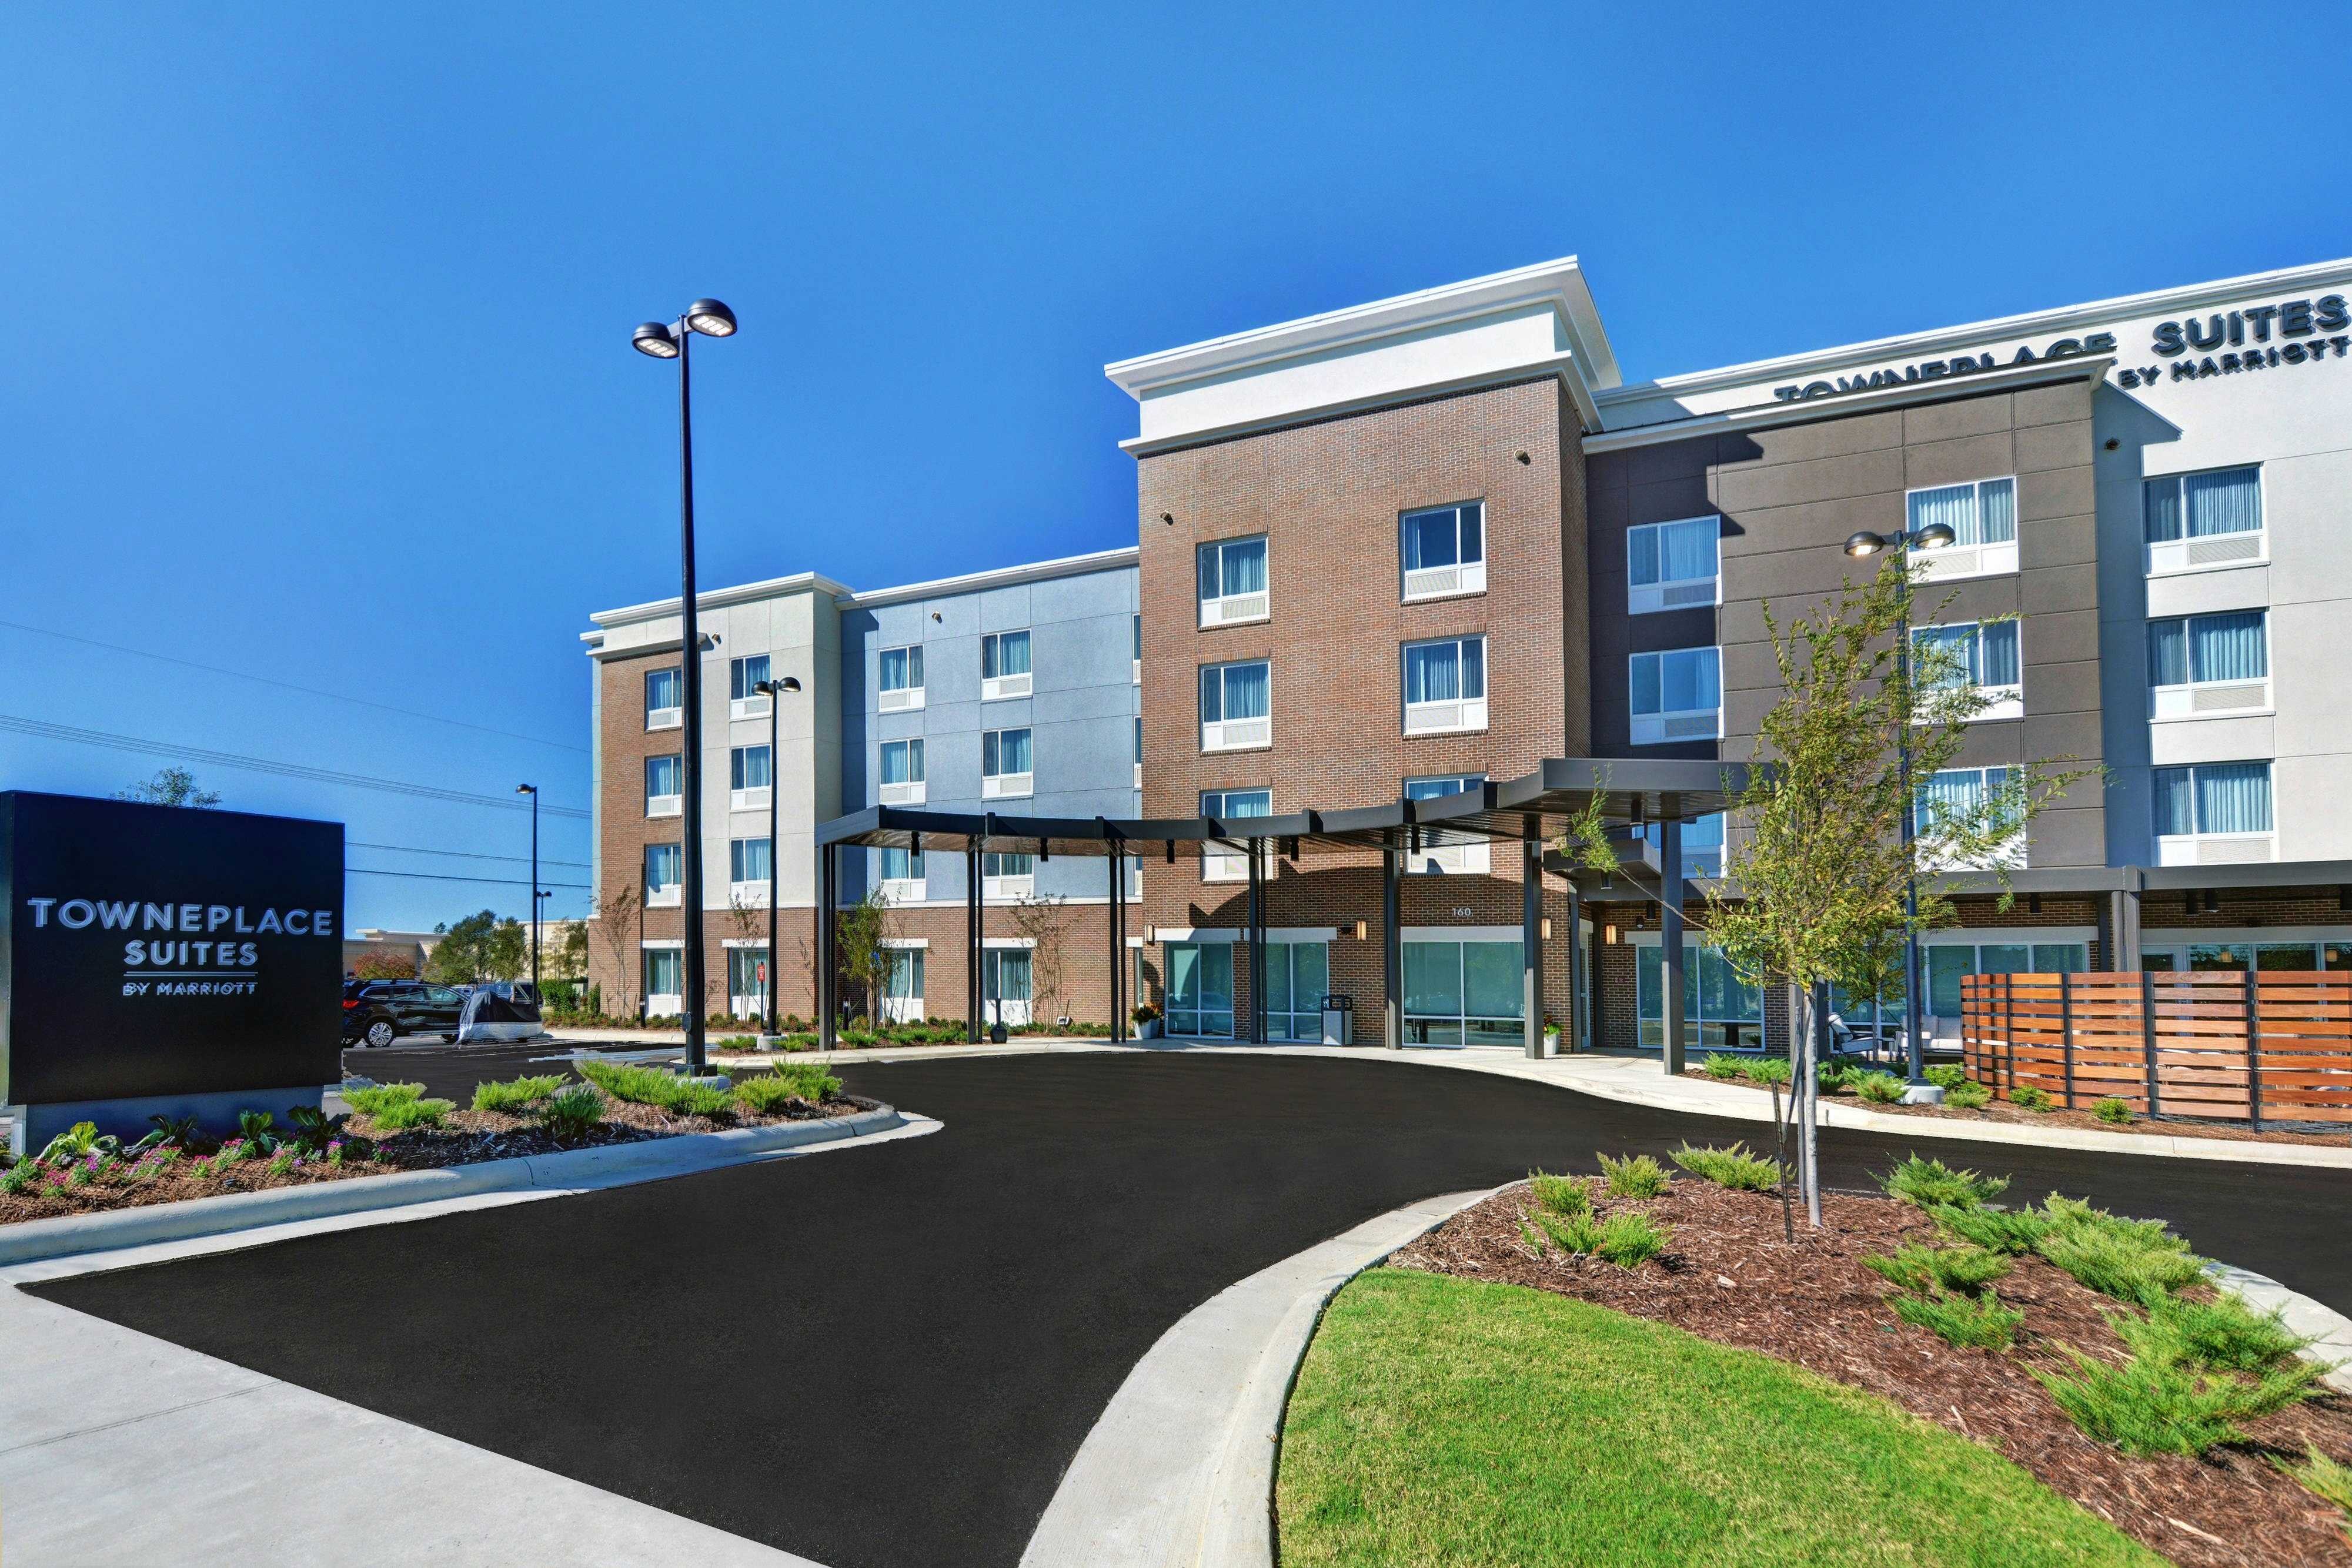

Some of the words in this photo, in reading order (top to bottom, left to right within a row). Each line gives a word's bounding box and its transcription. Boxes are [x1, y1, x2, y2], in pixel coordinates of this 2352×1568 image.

[2151, 294, 2351, 357] SUITES
[2118, 365, 2162, 390] BY
[2170, 335, 2352, 383] MARRIOTT
[28, 897, 332, 935] TOWNEPLACE
[1453, 907, 1471, 916] 160
[123, 940, 258, 965] SUITES
[123, 982, 151, 995] BY
[156, 982, 258, 995] MARRIOTT
